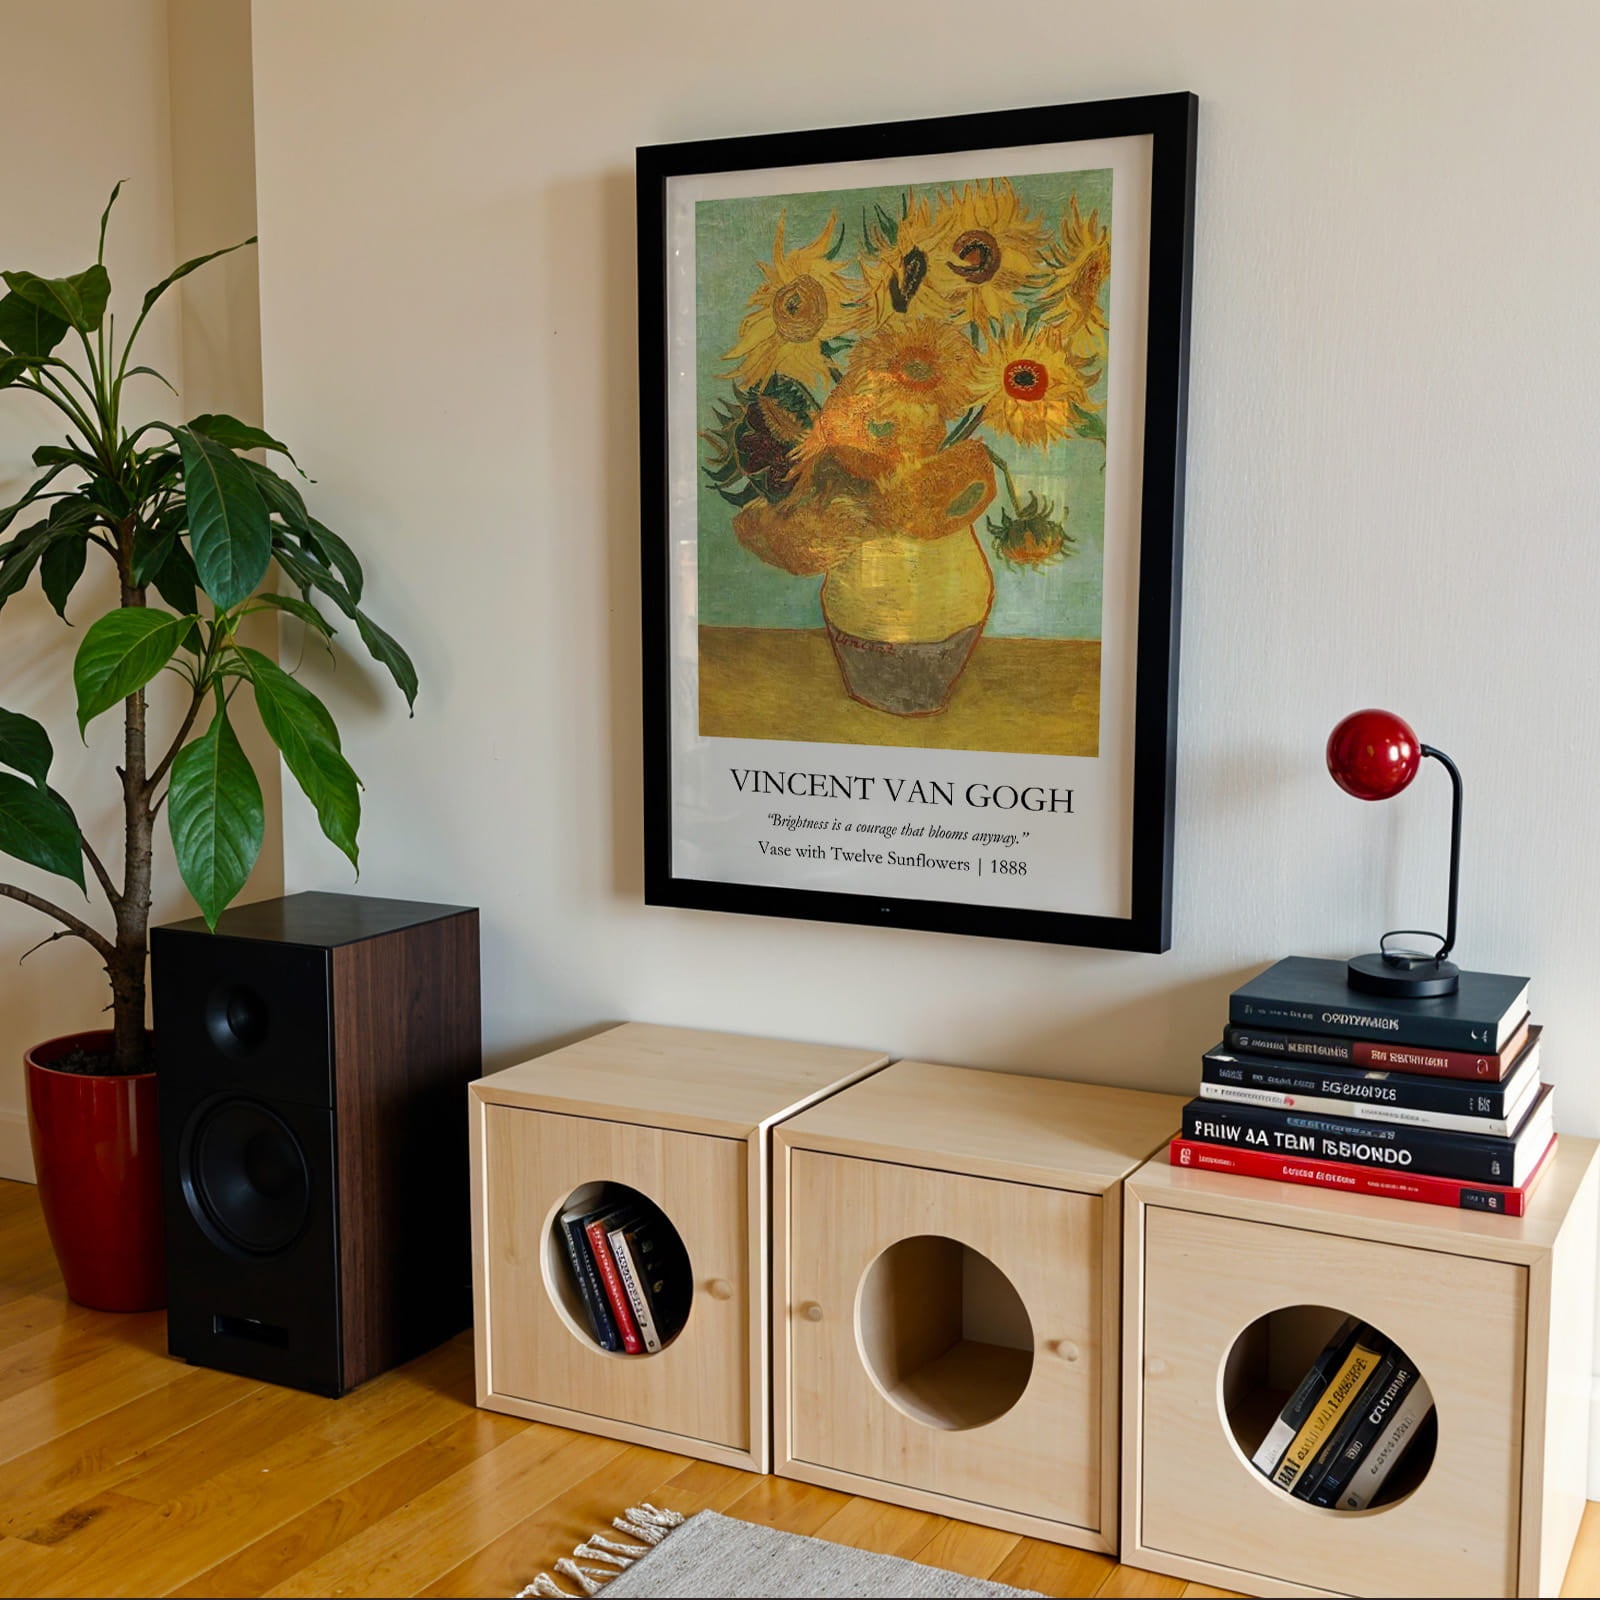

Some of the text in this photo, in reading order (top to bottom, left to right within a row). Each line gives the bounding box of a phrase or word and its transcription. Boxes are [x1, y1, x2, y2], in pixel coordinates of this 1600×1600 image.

[730, 768, 1075, 814] VINCENT VAN GOGH
[767, 813, 1030, 848] “Brightness is a courage that blooms anyway.”
[758, 840, 792, 857] Vase
[795, 844, 826, 860] with
[830, 846, 884, 865] Twelve
[887, 850, 971, 872] Sunflowers
[991, 858, 1028, 877] 1888
